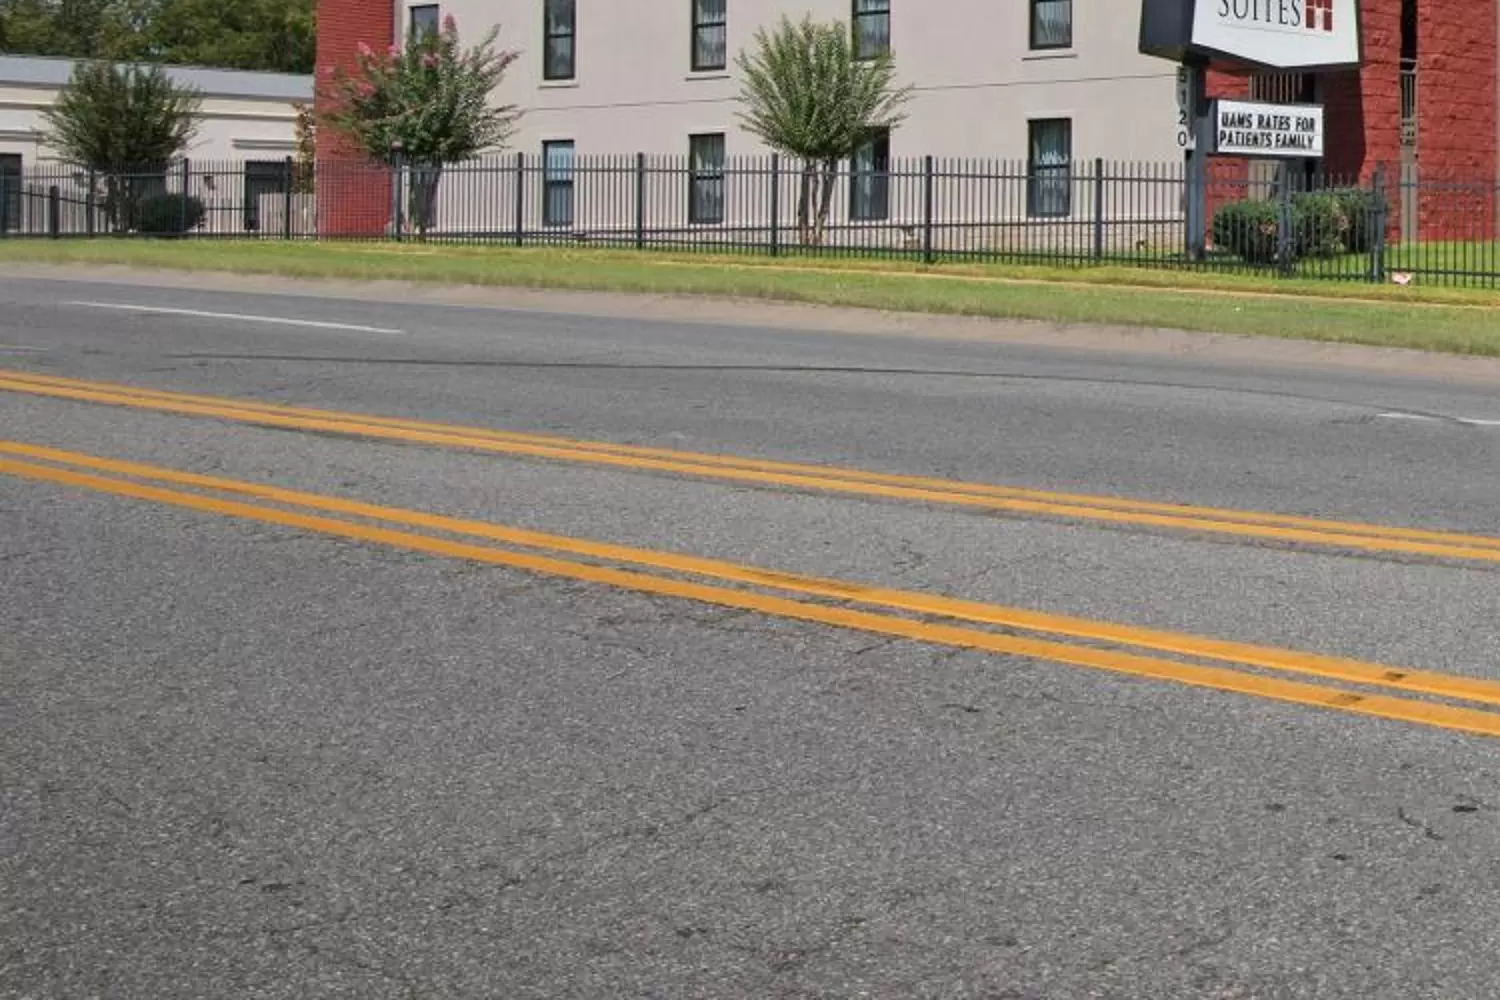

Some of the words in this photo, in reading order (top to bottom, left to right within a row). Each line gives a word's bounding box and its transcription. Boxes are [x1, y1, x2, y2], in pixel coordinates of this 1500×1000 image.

[1221, 112, 1252, 128] UAMS
[1257, 114, 1290, 130] RATES
[1296, 116, 1315, 132] FOR
[1219, 130, 1273, 147] PATIENTS
[1274, 133, 1315, 149] FAMILY
